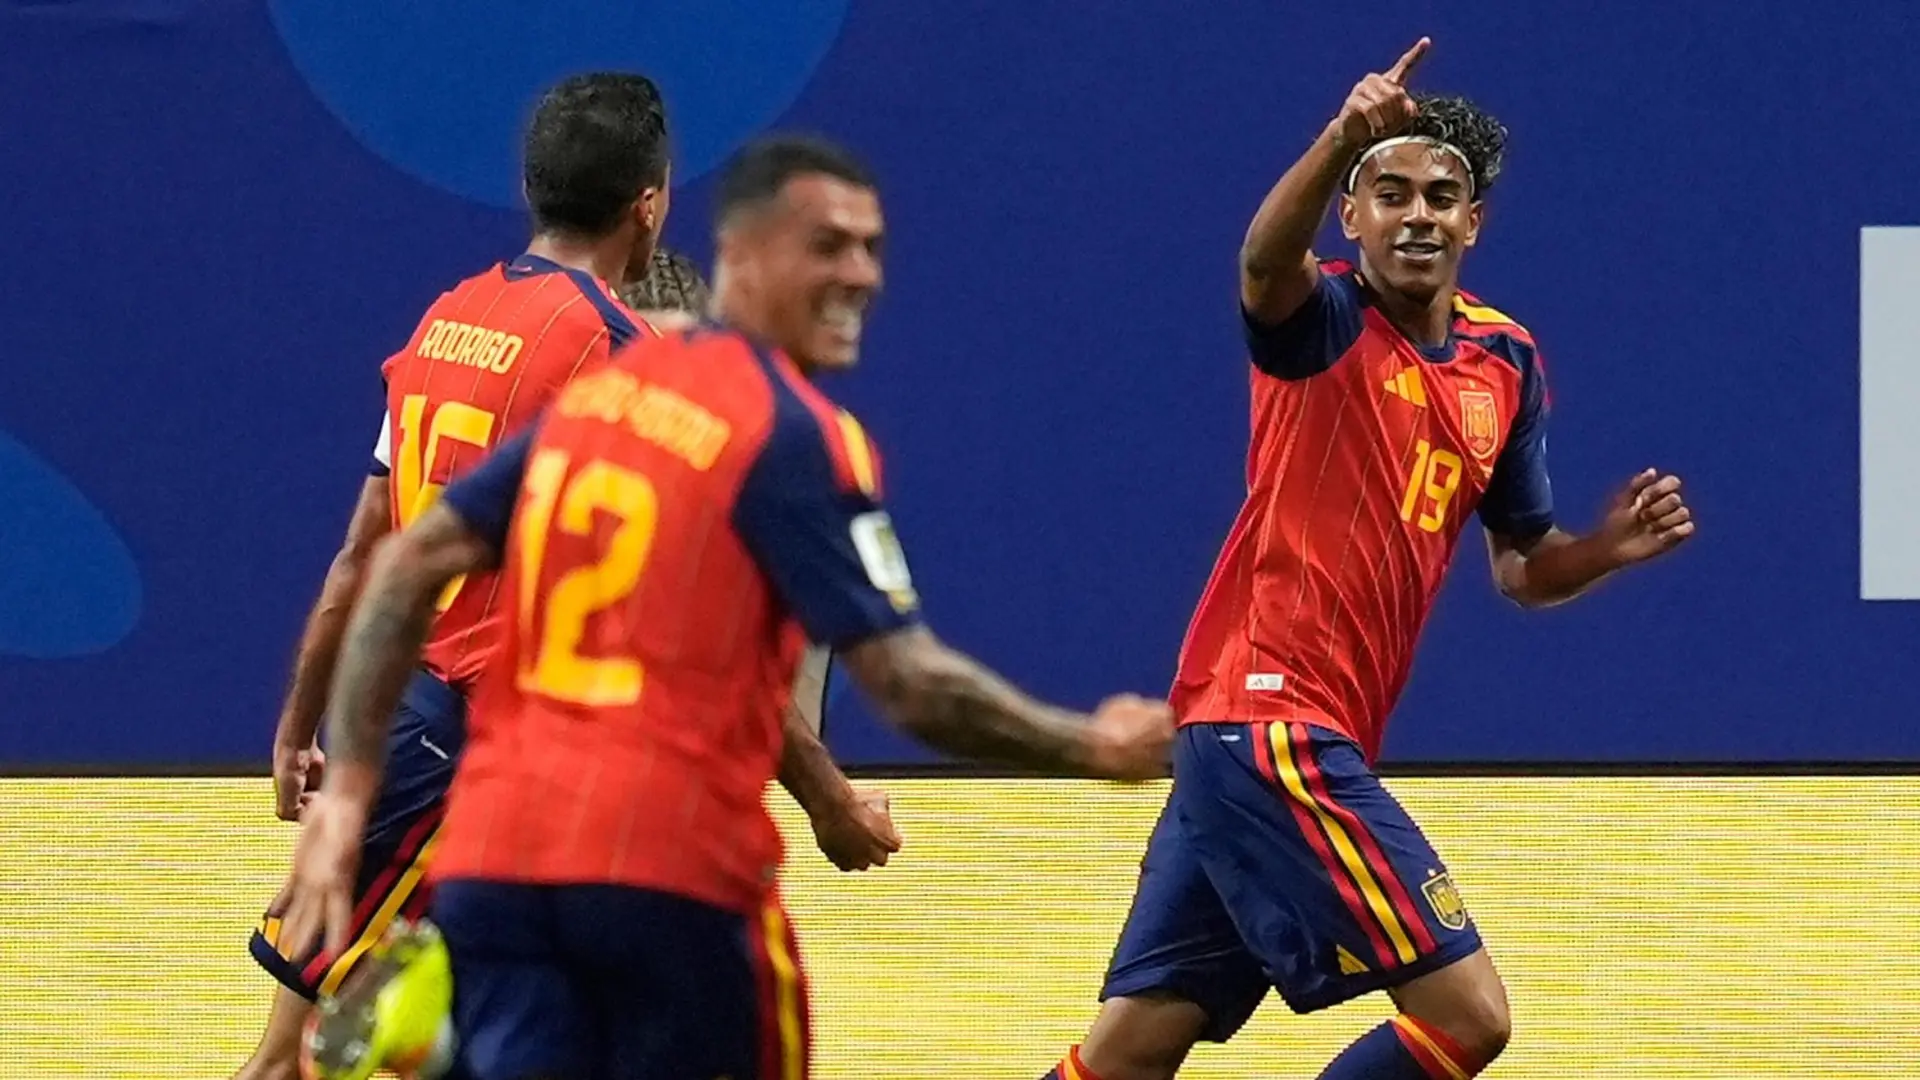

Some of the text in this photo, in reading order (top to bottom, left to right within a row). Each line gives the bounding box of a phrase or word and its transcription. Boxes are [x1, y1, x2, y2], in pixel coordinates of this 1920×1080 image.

[417, 319, 524, 374] RODRIGO
[1401, 440, 1462, 532] 19
[517, 449, 658, 705] 12
